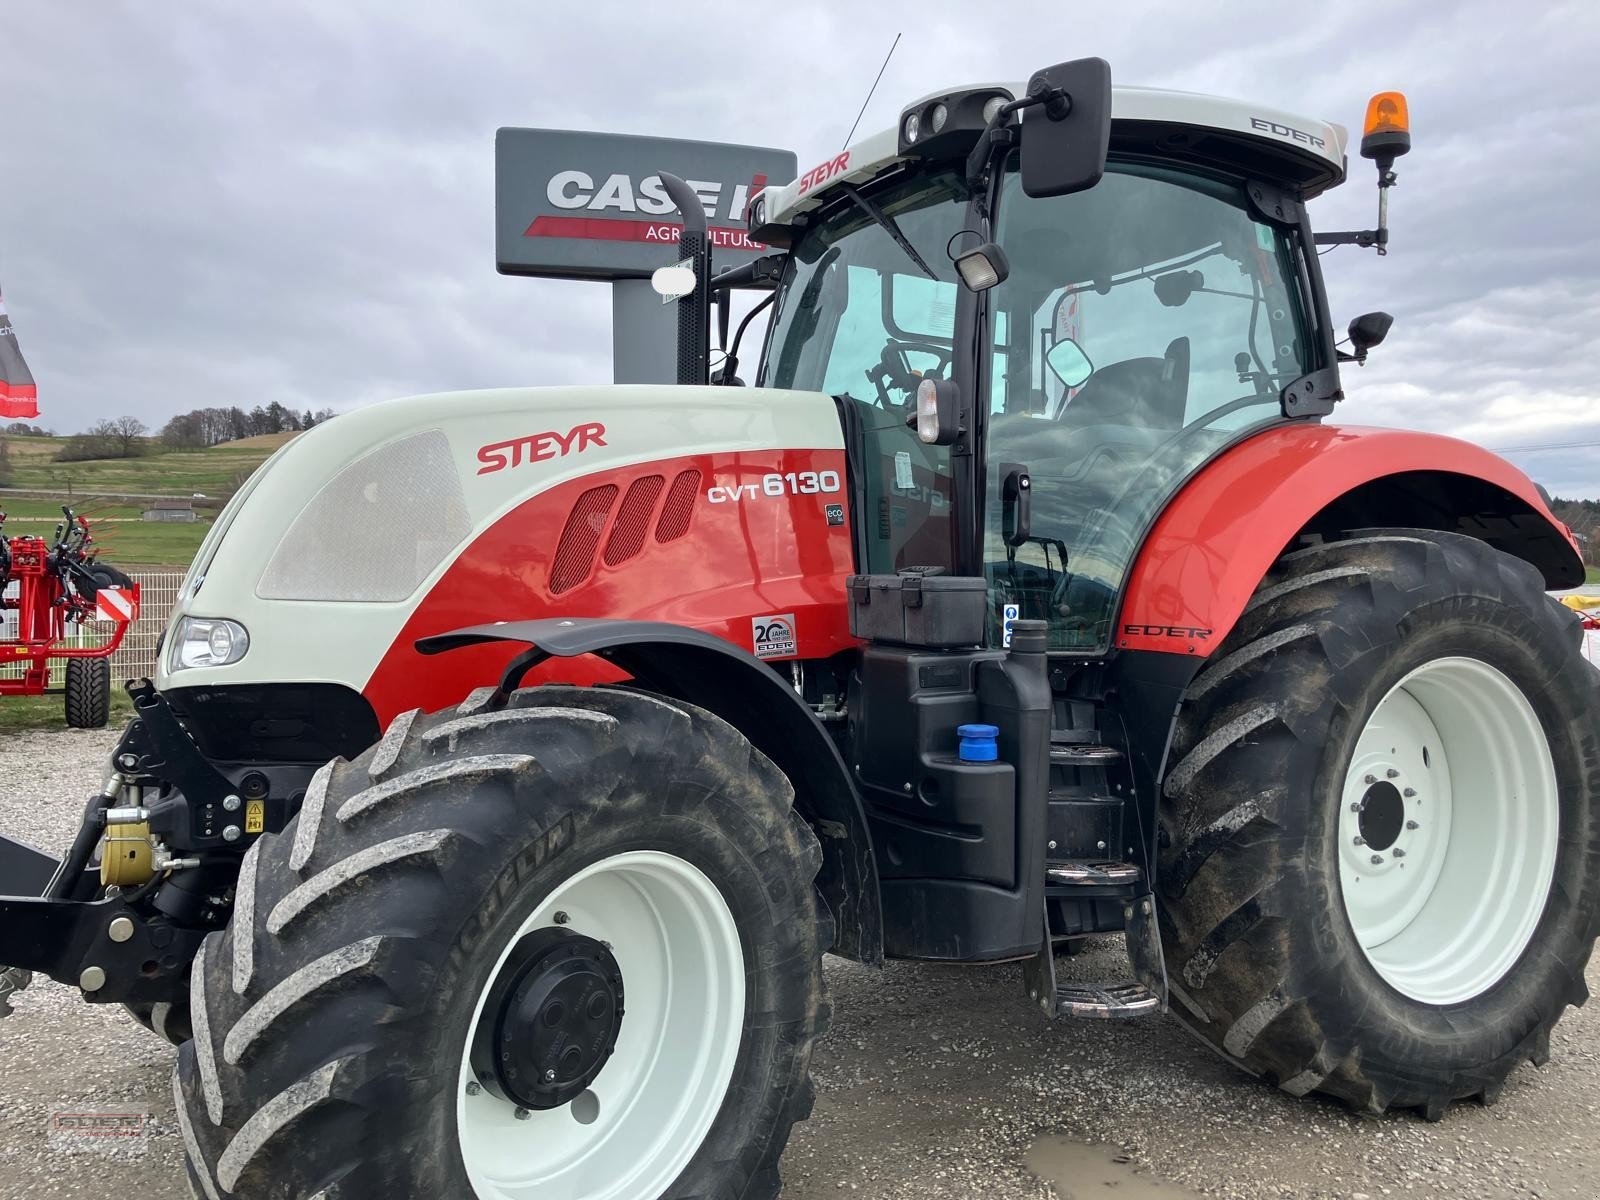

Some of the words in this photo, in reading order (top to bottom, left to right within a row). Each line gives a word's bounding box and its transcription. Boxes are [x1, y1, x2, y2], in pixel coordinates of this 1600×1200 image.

[1249, 117, 1326, 149] EDER
[798, 151, 850, 195] STEYR
[546, 169, 722, 218] CASE
[476, 422, 608, 476] STEYR
[763, 470, 840, 497] 6130
[827, 509, 843, 518] eco
[771, 629, 791, 637] JAHRE
[1123, 624, 1213, 640] EDER
[757, 641, 793, 651] EDER
